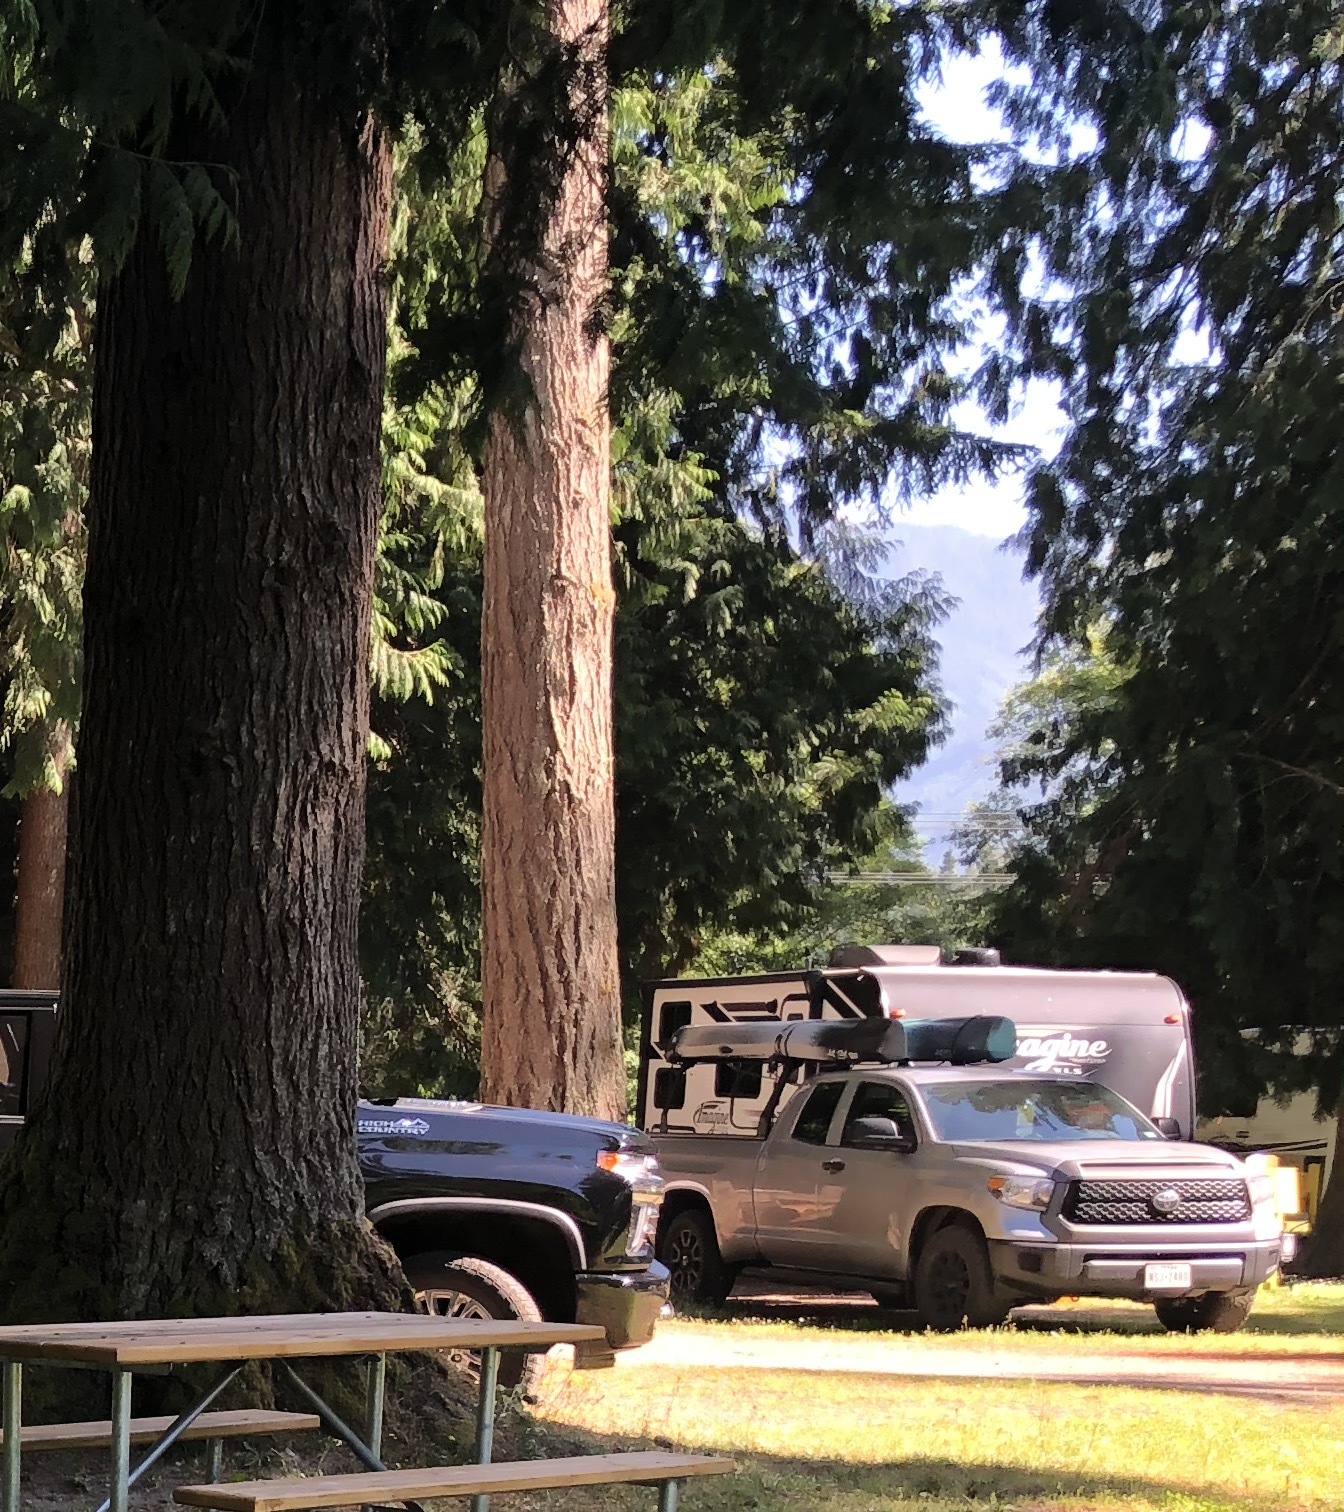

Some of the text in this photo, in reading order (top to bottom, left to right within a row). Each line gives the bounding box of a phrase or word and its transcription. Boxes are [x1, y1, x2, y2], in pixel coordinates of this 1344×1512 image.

[1015, 1032, 1112, 1072] agine
[357, 1119, 395, 1127] HIGH
[357, 1126, 429, 1135] COUNTRY
